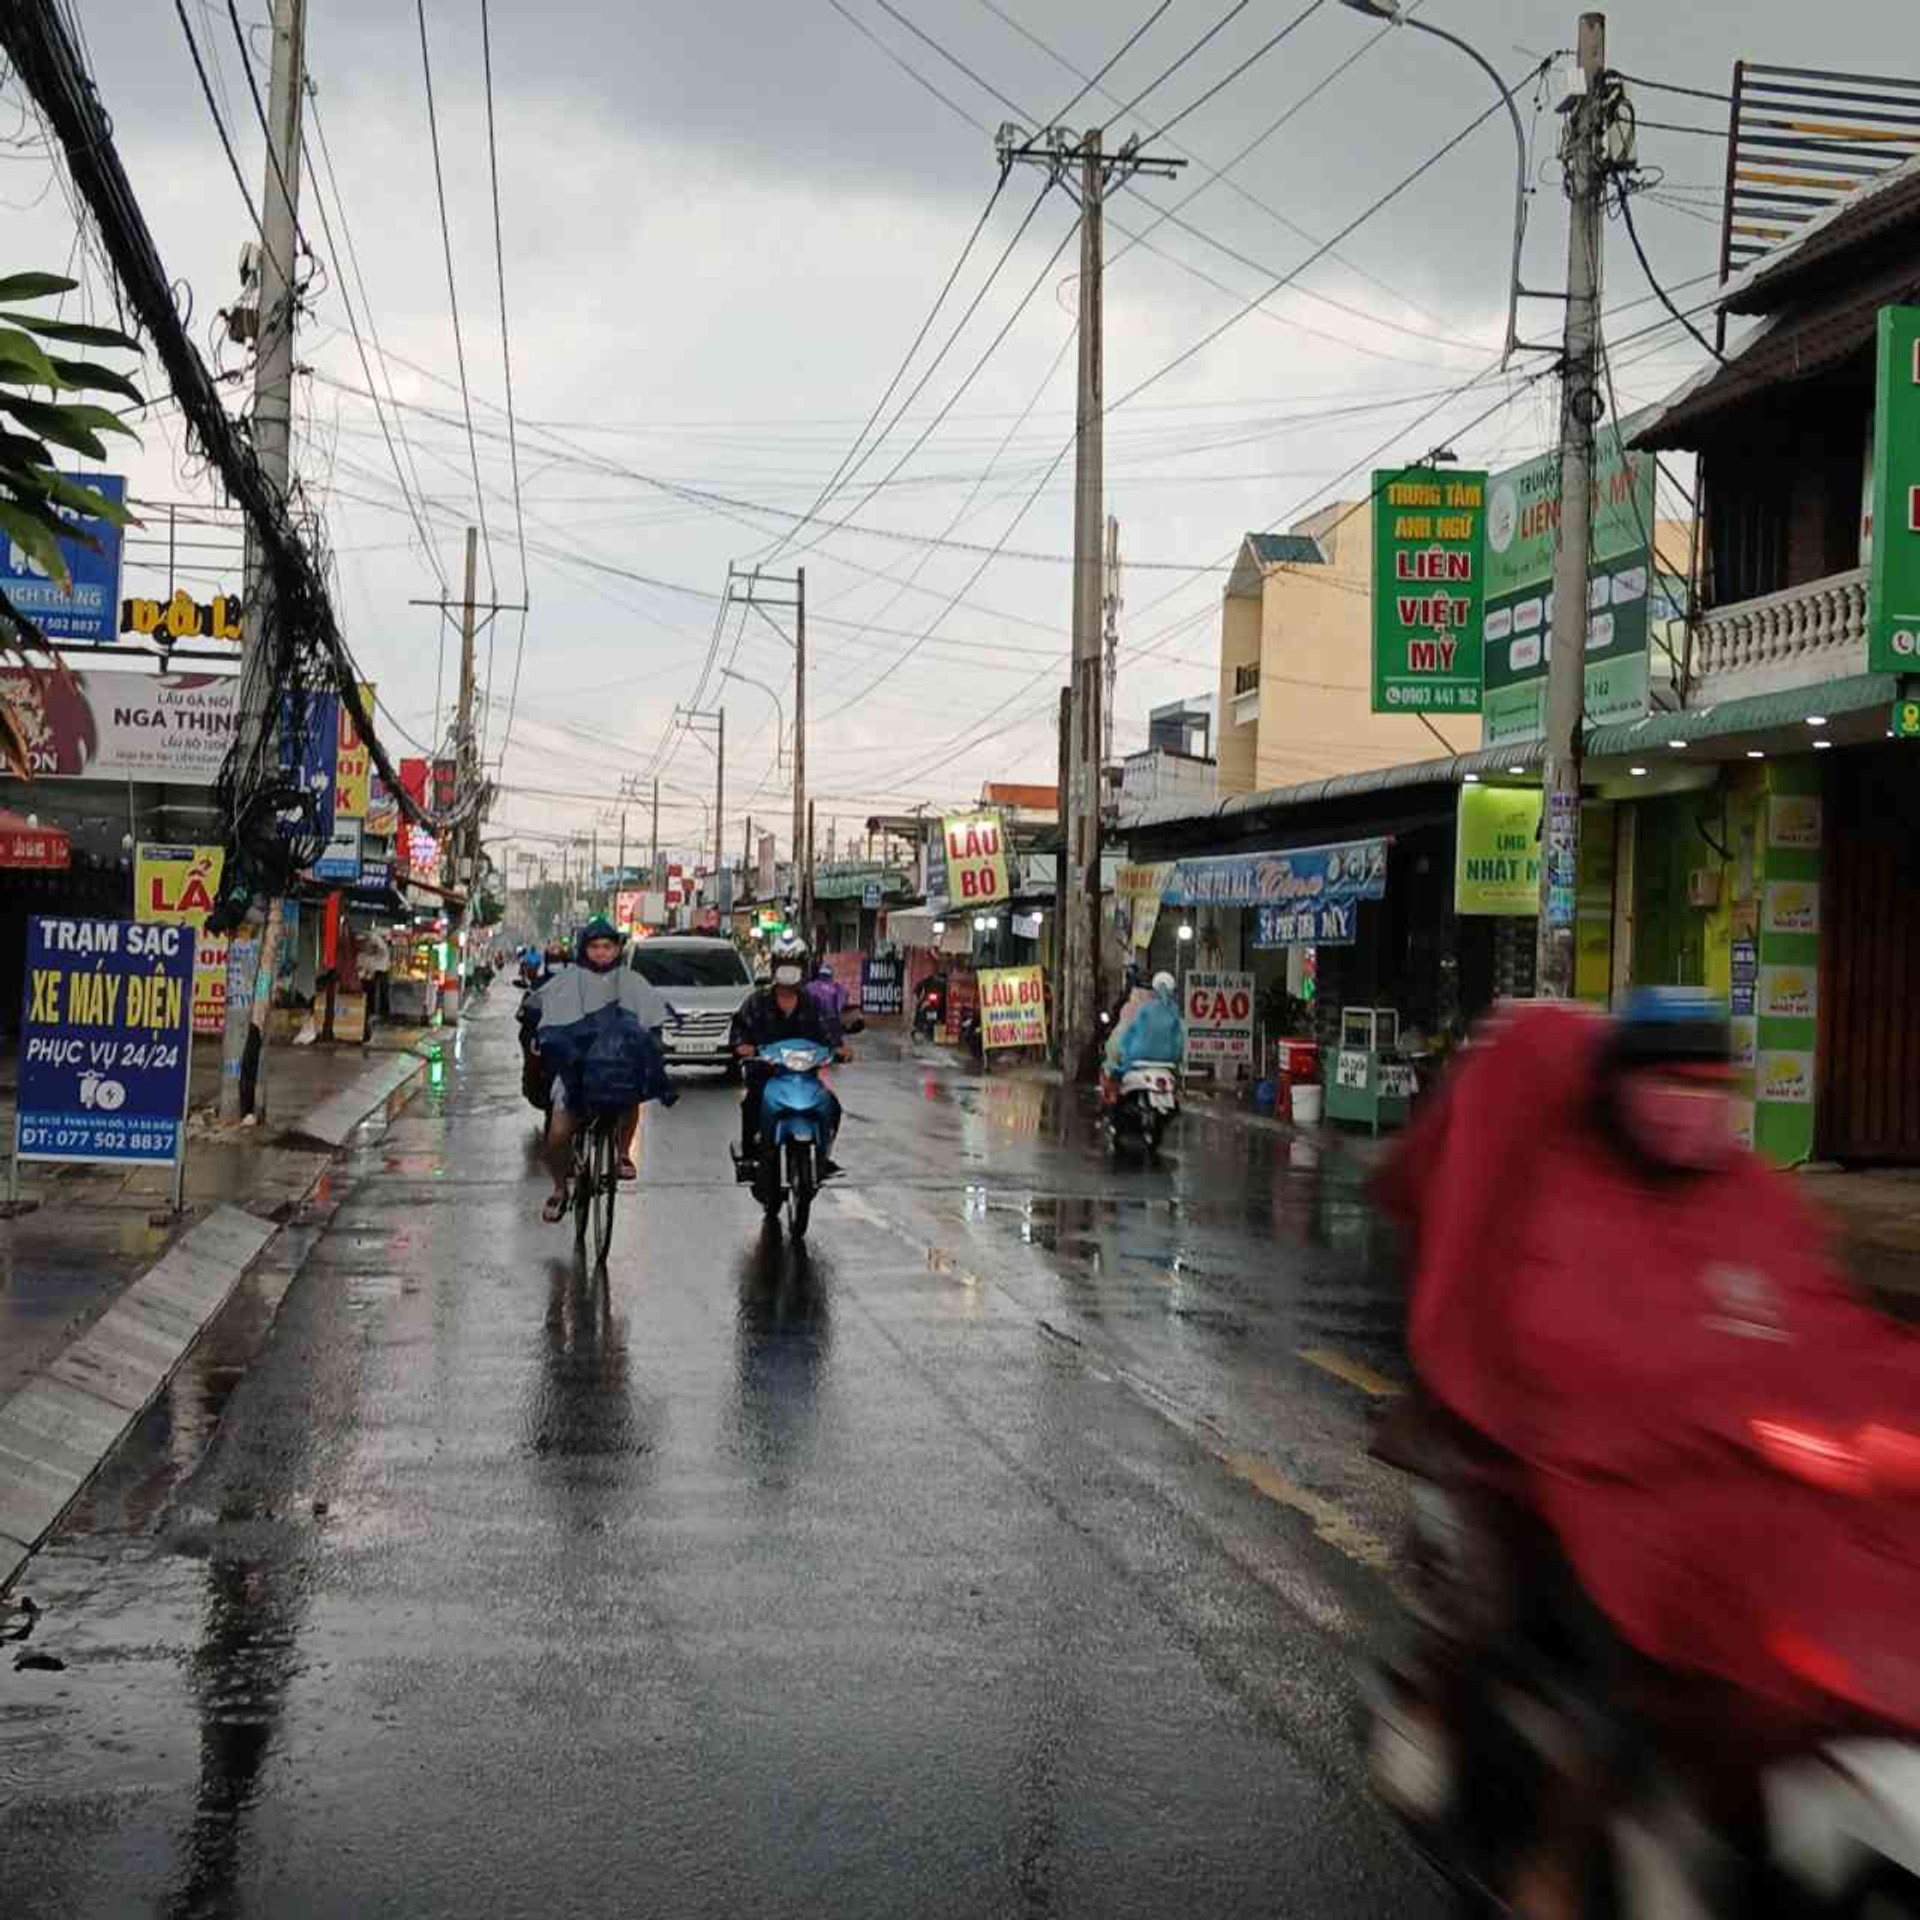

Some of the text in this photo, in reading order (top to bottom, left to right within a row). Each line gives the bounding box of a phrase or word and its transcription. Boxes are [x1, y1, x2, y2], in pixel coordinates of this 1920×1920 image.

[1388, 483, 1441, 506] TRUNG
[1397, 544, 1471, 581] LIÊN
[1397, 590, 1471, 634] VIỆT
[1408, 634, 1458, 672] MỸ
[114, 707, 167, 728] NGA
[152, 858, 214, 912] LẨ
[40, 920, 180, 961] TRẠM SẠC
[29, 969, 62, 1024] XE
[68, 958, 121, 1026] MÁY
[125, 962, 182, 1041] ĐIỆN
[1189, 991, 1249, 1028] GẠO
[26, 1038, 178, 1070] PHỤC VỤ 24/24
[22, 1128, 174, 1150] ĐT: 077 502 8837
